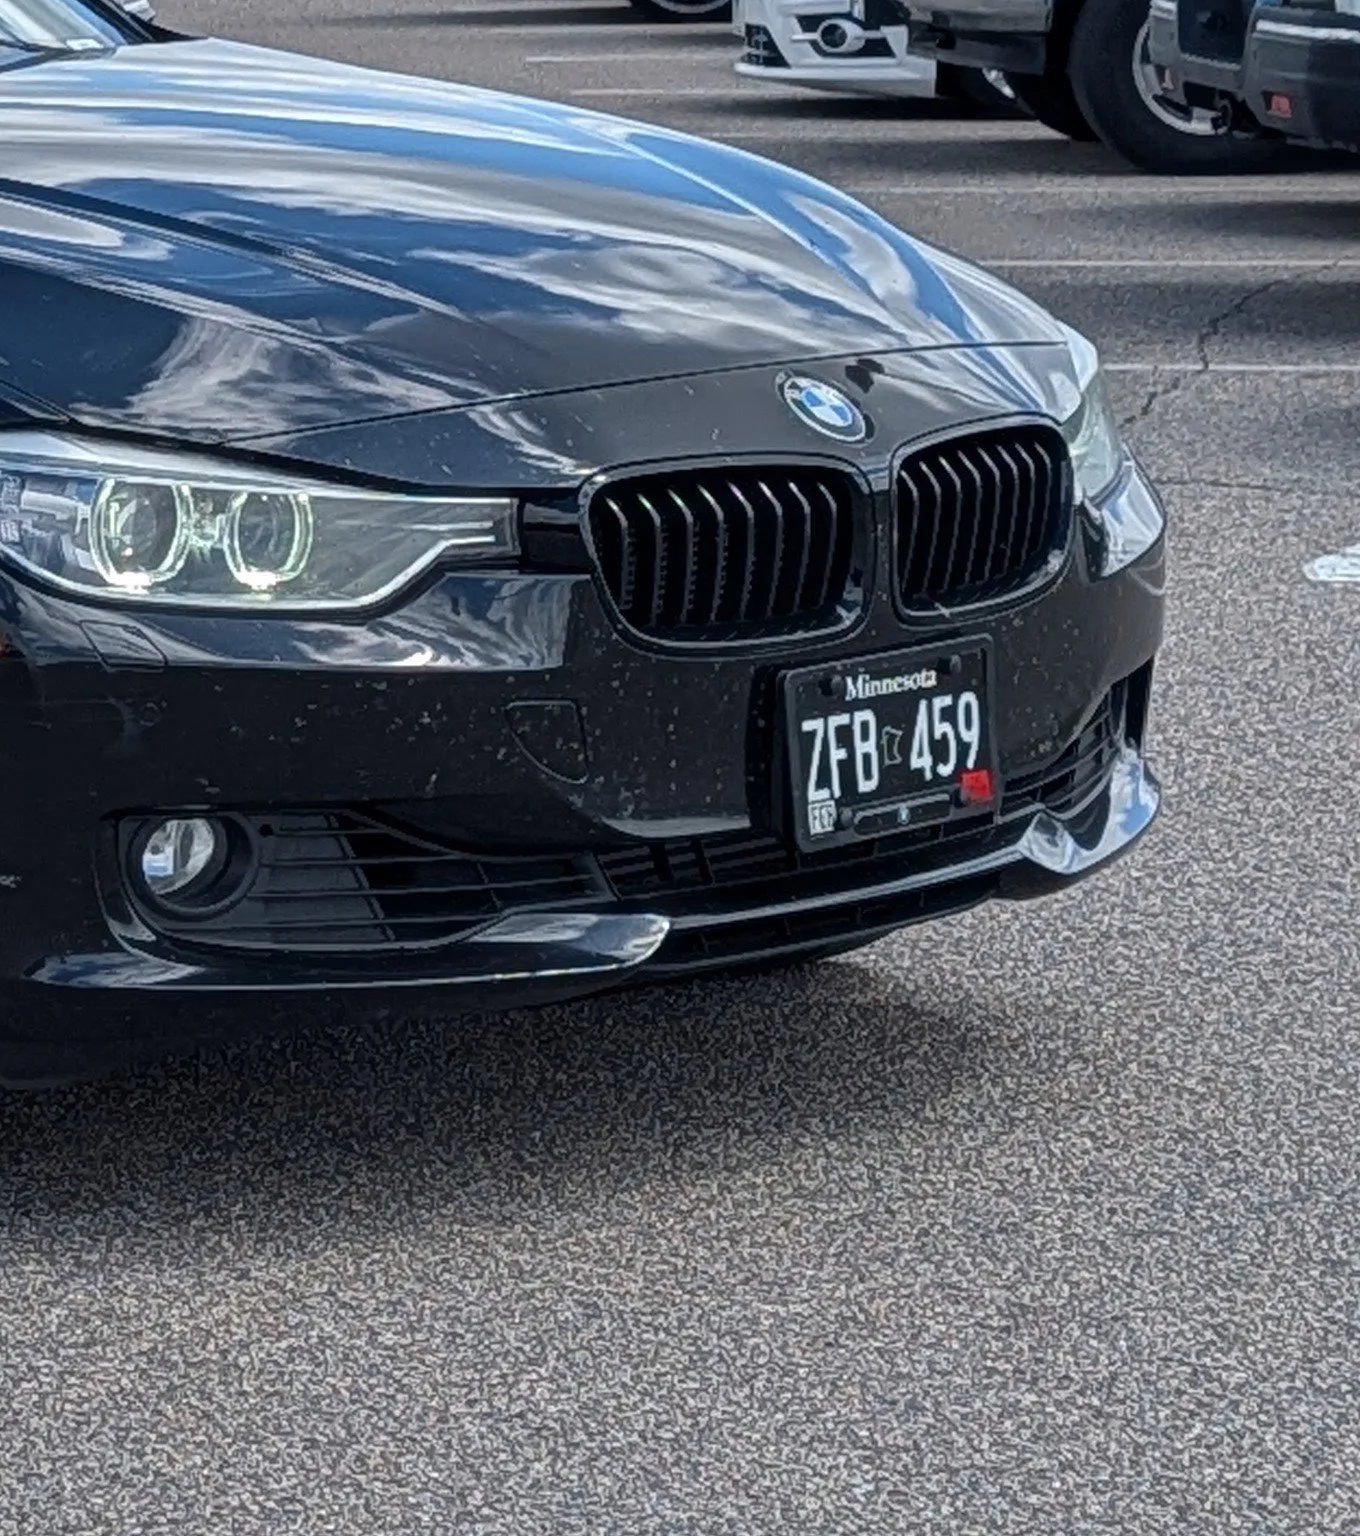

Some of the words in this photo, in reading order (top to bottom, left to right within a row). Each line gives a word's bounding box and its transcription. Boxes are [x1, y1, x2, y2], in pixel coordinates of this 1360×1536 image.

[844, 667, 938, 701] Minnesota
[801, 709, 880, 802] ZFB
[910, 691, 980, 781] 459
